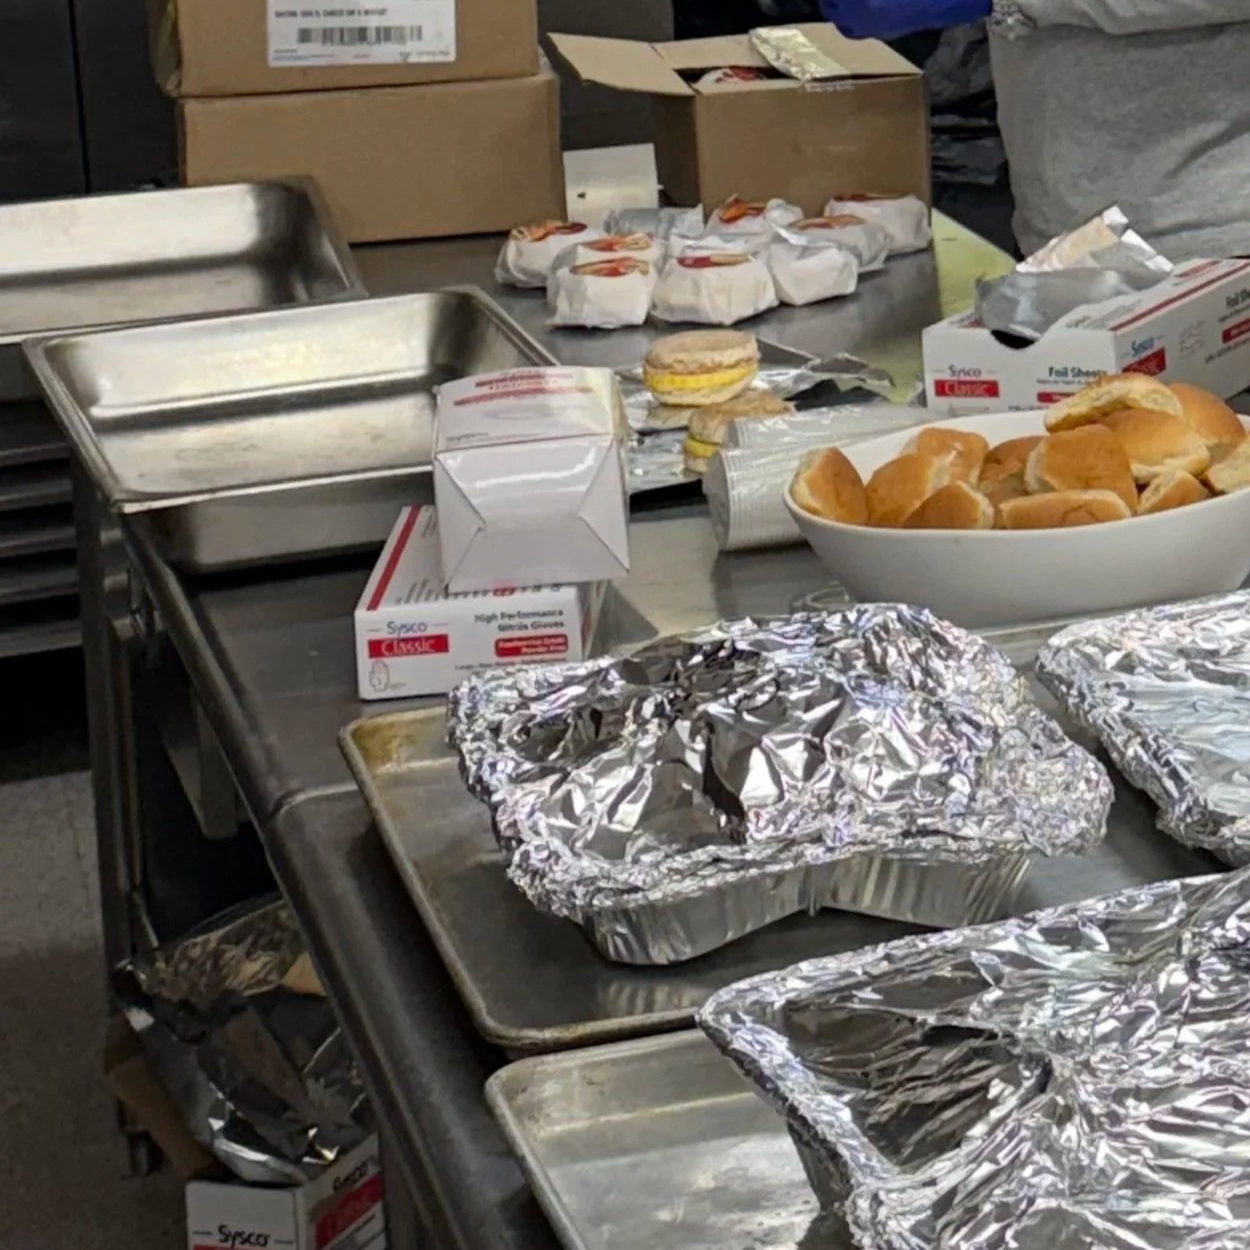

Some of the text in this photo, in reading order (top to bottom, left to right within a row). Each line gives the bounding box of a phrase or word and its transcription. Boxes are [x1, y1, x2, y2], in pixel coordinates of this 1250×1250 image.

[948, 364, 982, 379] Sysco
[1048, 366, 1069, 378] Foil
[944, 381, 989, 396] Classic
[386, 620, 428, 636] Sysco
[381, 637, 435, 656] Classic
[218, 1225, 271, 1248] Sysco
